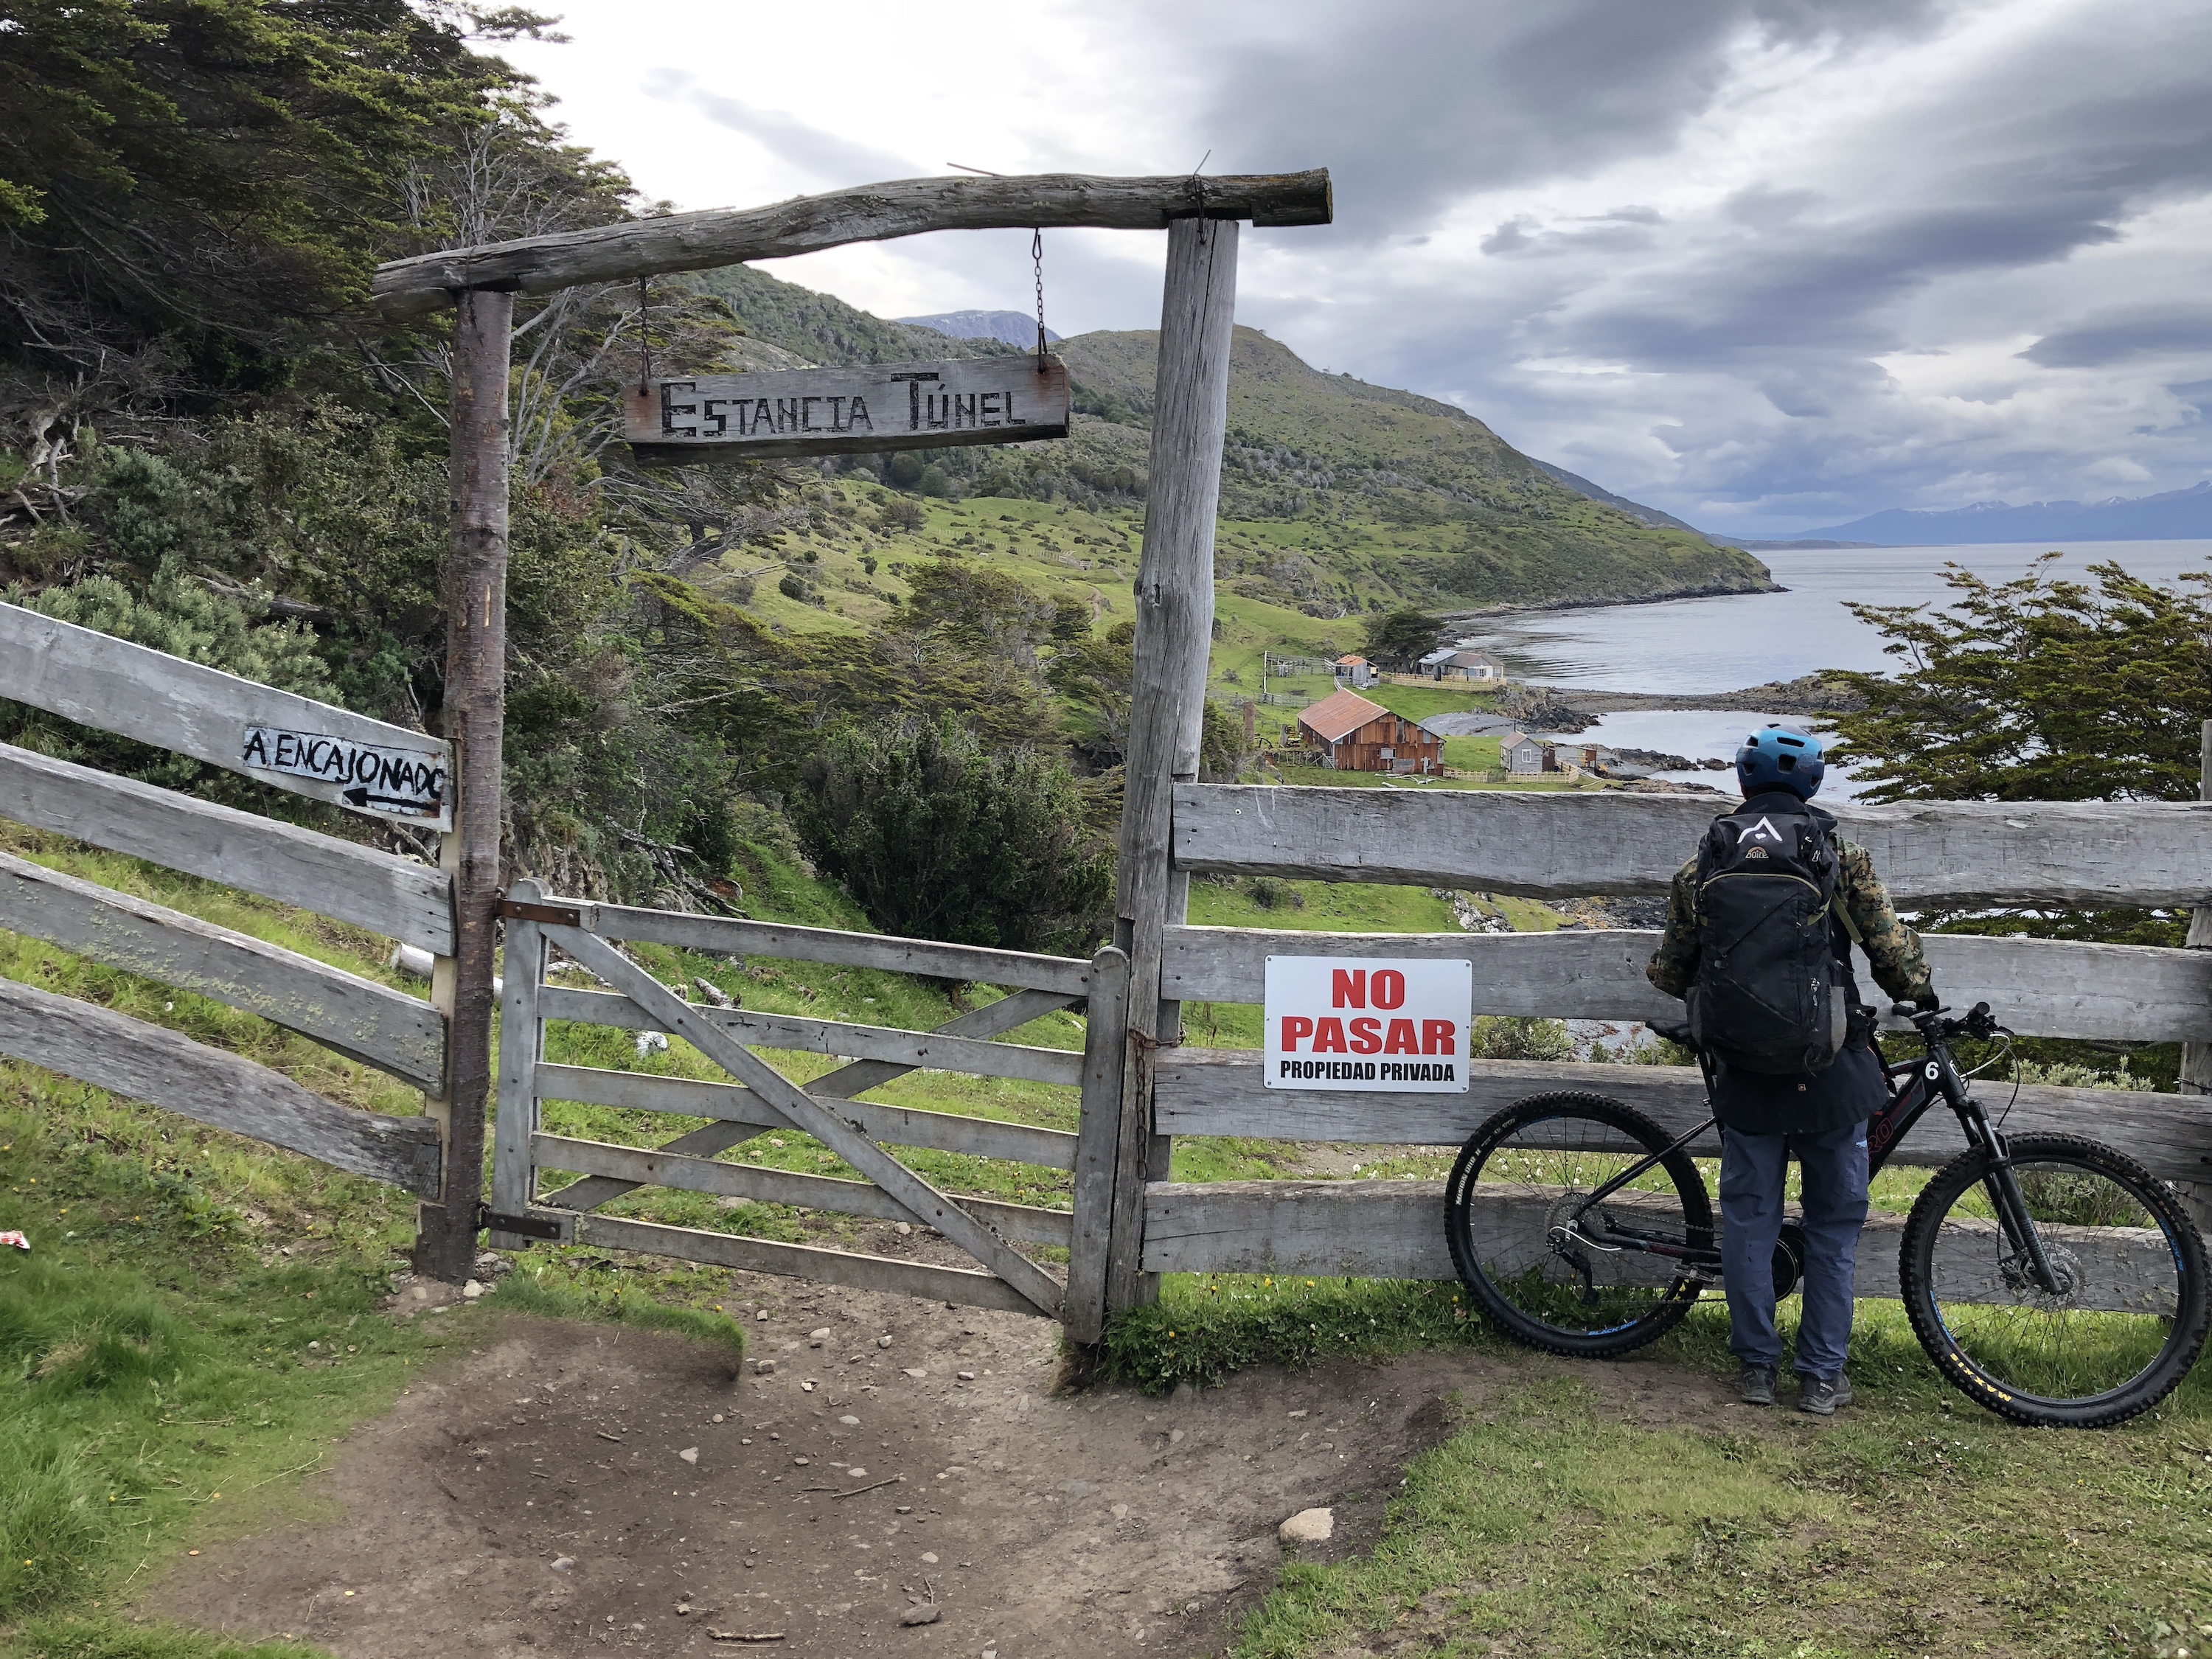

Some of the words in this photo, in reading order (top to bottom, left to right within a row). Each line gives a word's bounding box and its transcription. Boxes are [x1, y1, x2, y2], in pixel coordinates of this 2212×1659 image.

[661, 381, 874, 437] ESTANCIA
[891, 372, 1026, 431] TÚNEL
[243, 730, 267, 765] A
[1332, 968, 1405, 1010] NO
[1281, 1015, 1455, 1056] PASAR
[1280, 1060, 1377, 1081] PROPIEDAD
[1380, 1062, 1455, 1082] PRIVADA
[1925, 1061, 1939, 1080] 6
[1950, 1352, 2012, 1402] MAXXIS
